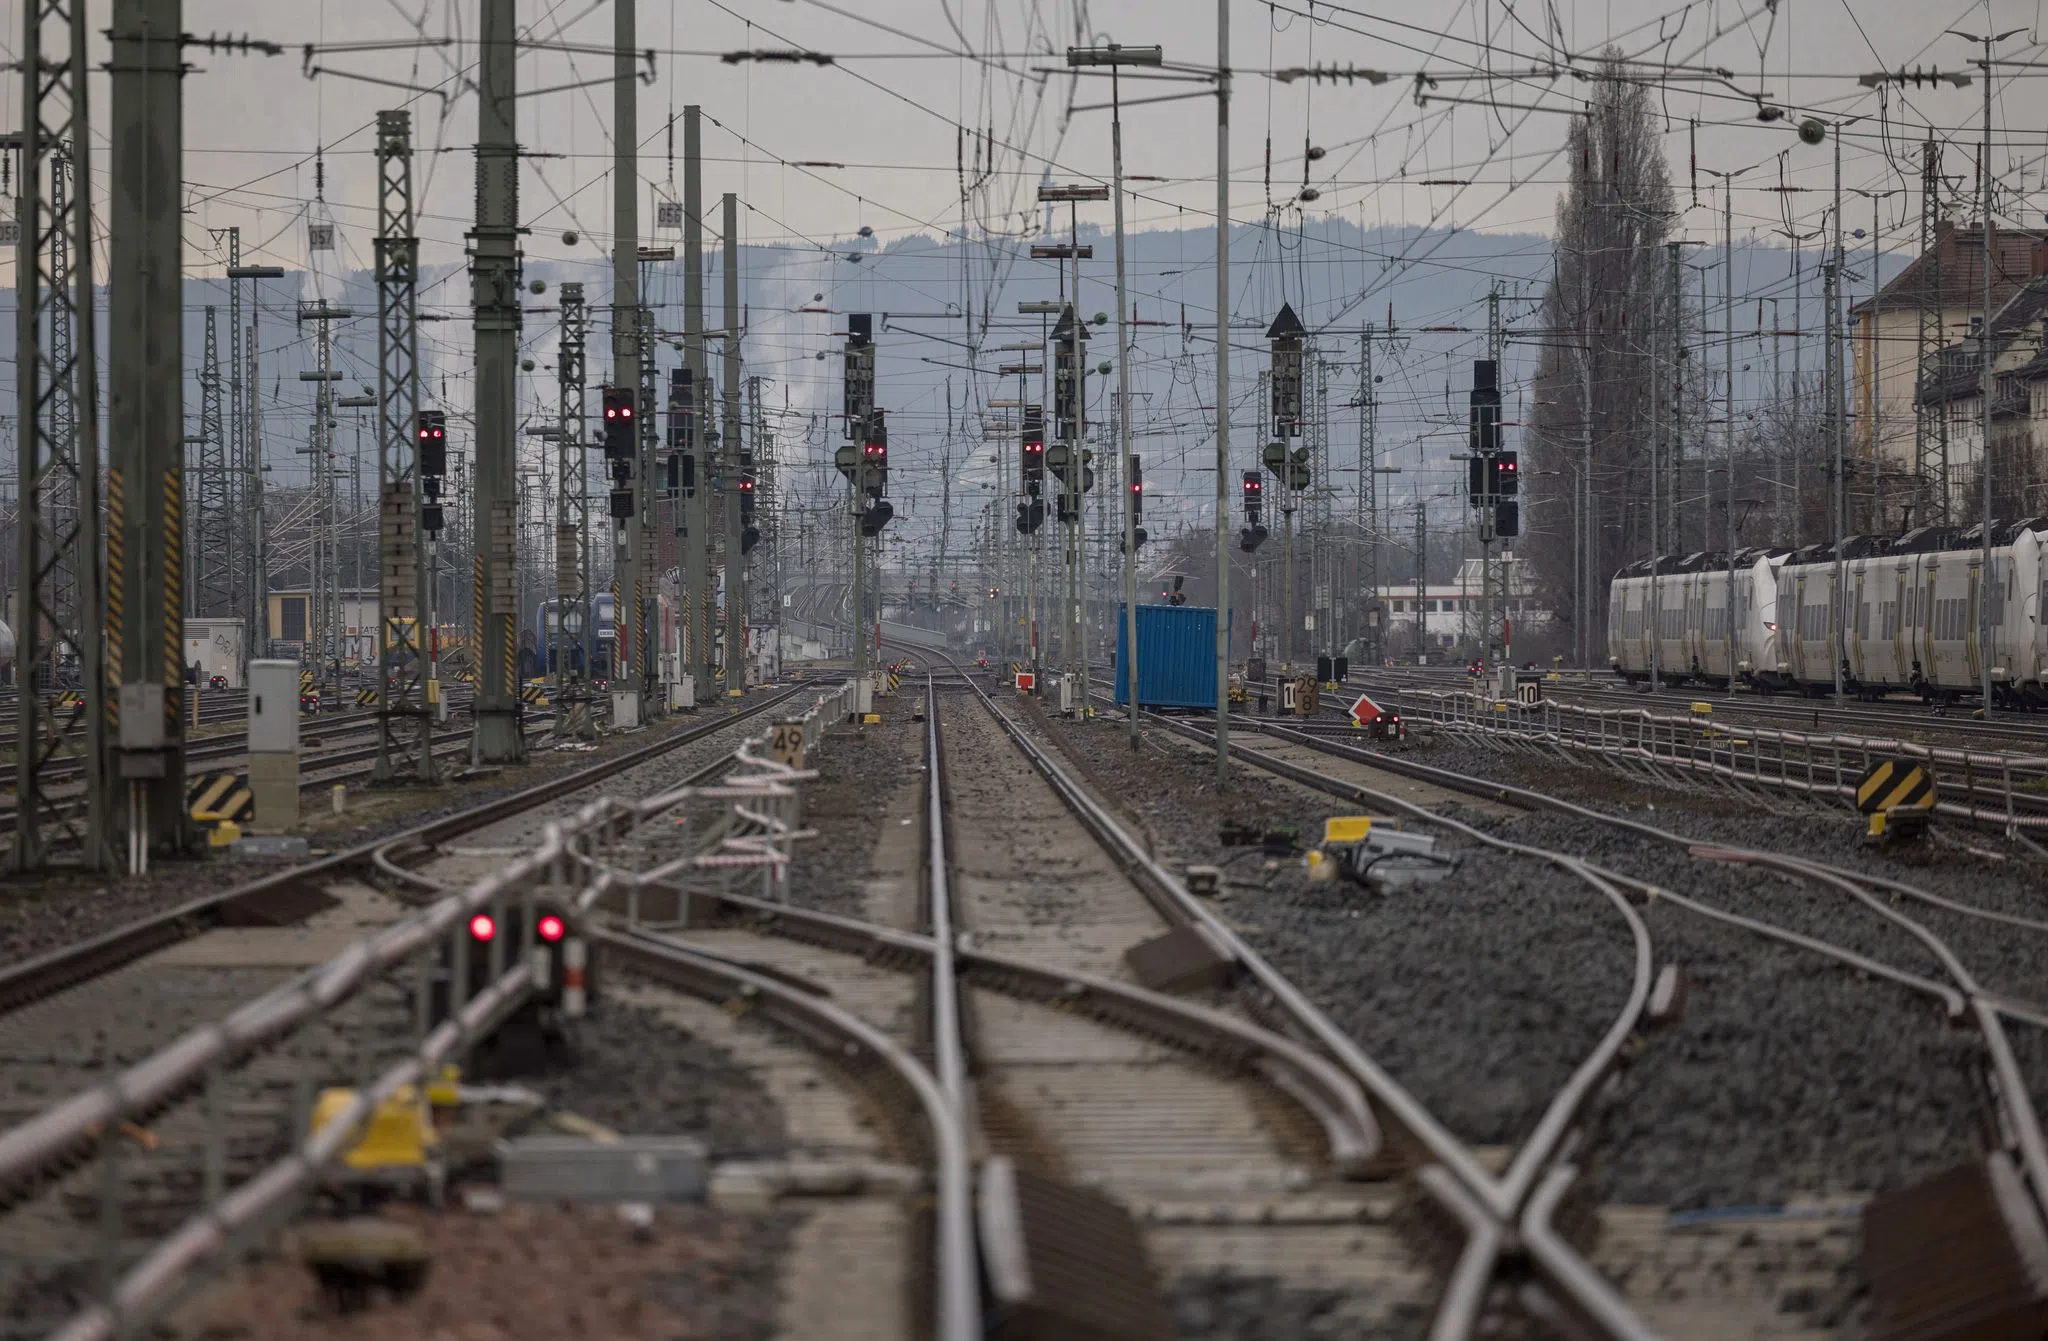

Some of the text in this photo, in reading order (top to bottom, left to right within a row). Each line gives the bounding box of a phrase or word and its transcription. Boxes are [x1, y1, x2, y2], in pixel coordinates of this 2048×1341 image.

[658, 207, 681, 223] 056
[310, 230, 333, 244] 057
[1296, 677, 1317, 693] 29
[1519, 686, 1536, 704] 10
[1302, 696, 1312, 711] 8
[773, 728, 802, 752] 49
